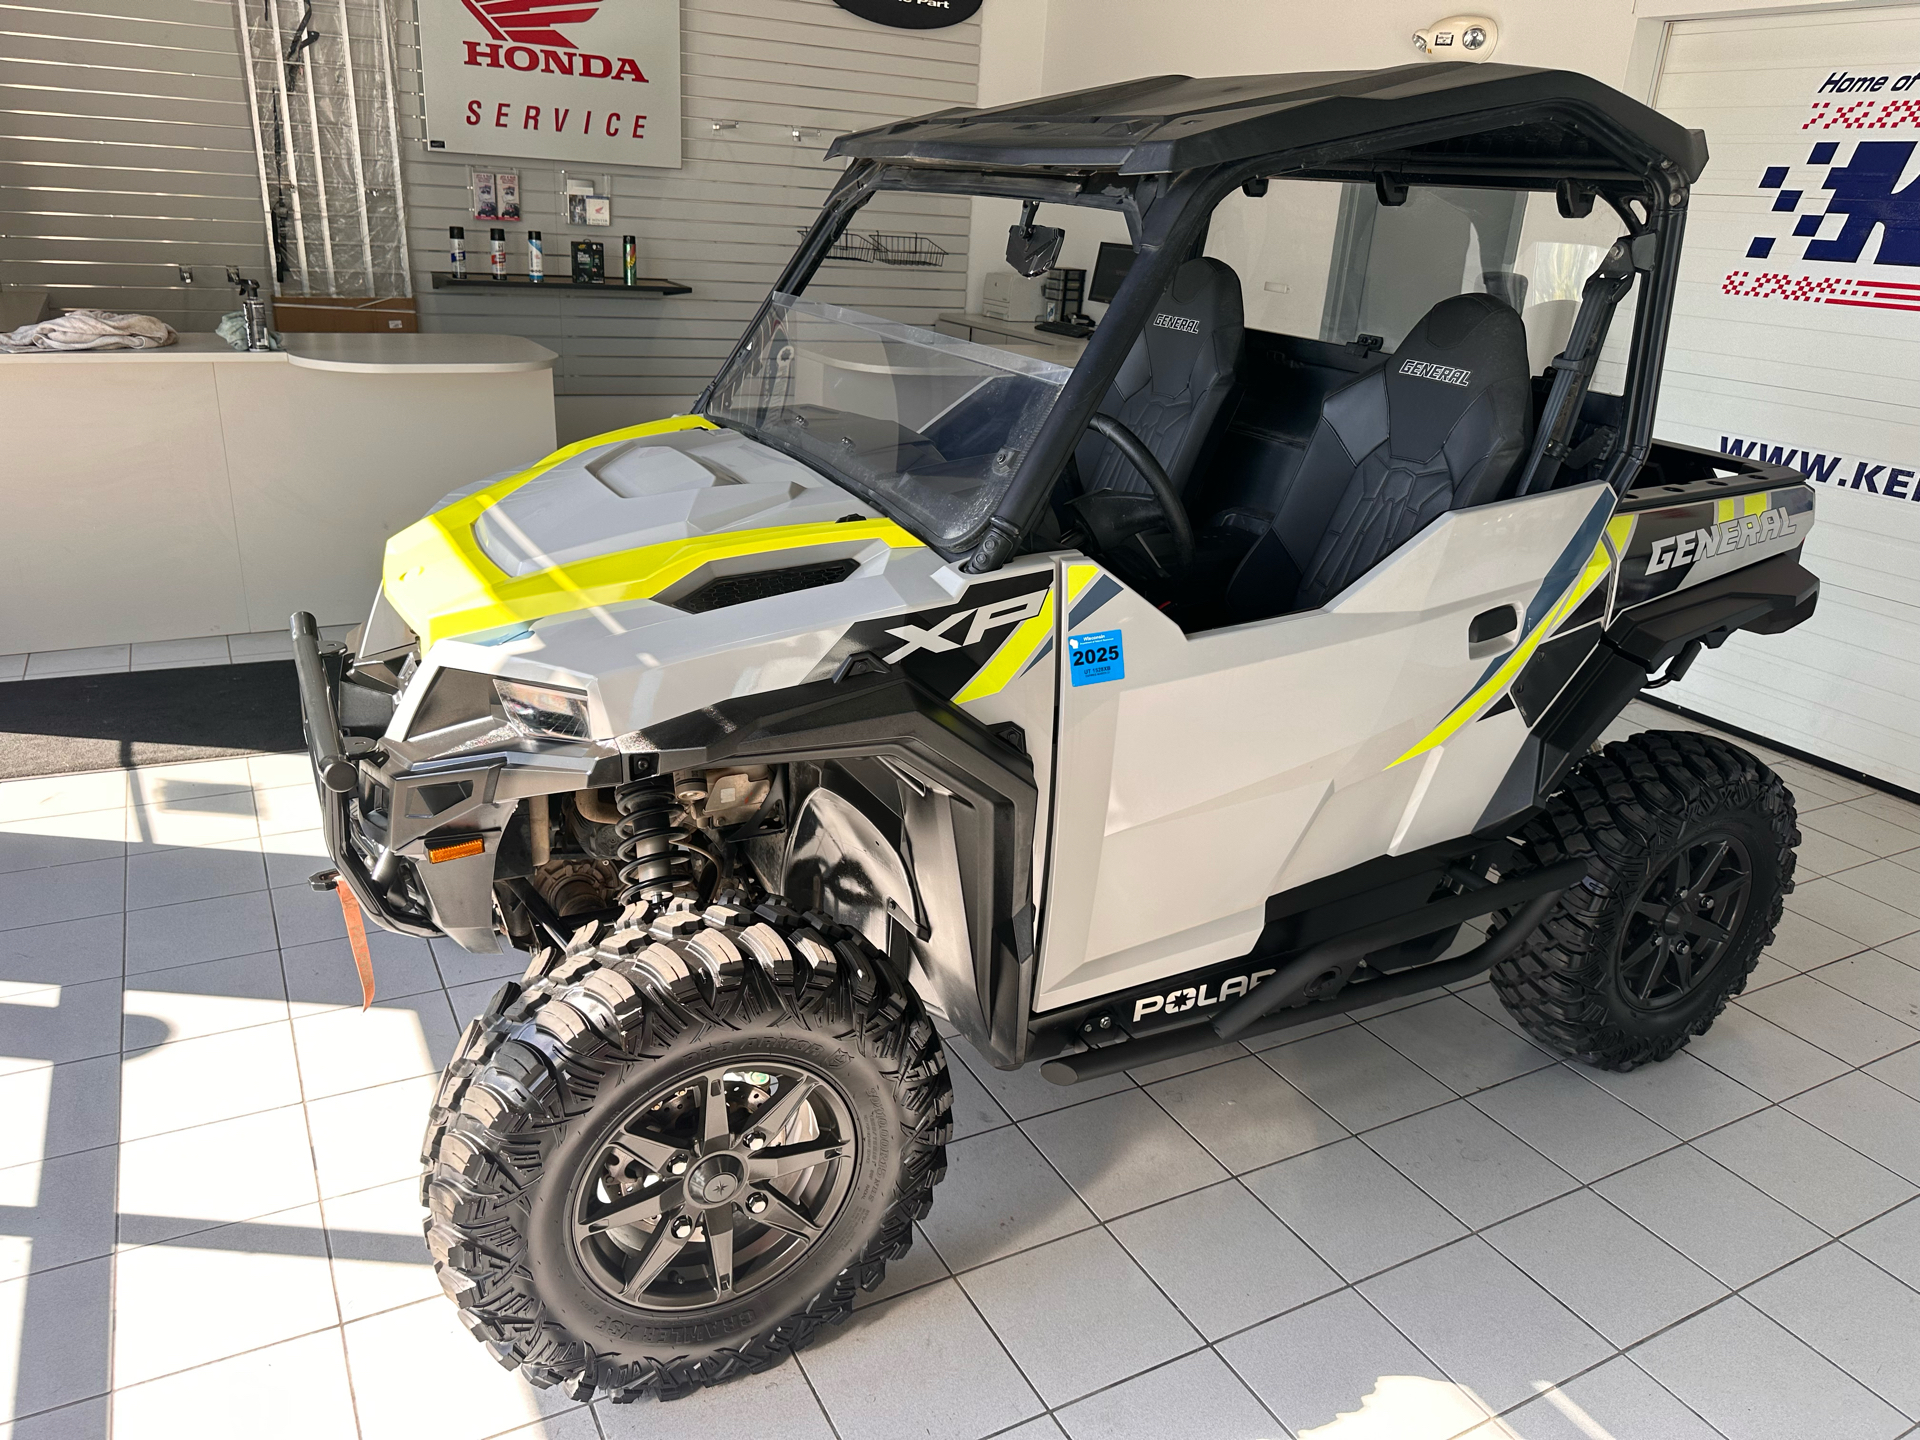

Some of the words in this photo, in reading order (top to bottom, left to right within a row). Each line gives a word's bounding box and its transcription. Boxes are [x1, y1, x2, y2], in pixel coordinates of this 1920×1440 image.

[463, 41, 649, 83] HONDA
[1818, 72, 1889, 93] Home
[465, 100, 648, 139] SERVICE
[1153, 313, 1200, 334] GENERAL
[1399, 358, 1473, 386] GENERAL
[1645, 507, 1797, 576] GENERAL
[882, 588, 1050, 664] XP
[1072, 645, 1119, 666] 2025
[740, 1036, 825, 1055] ARMOR
